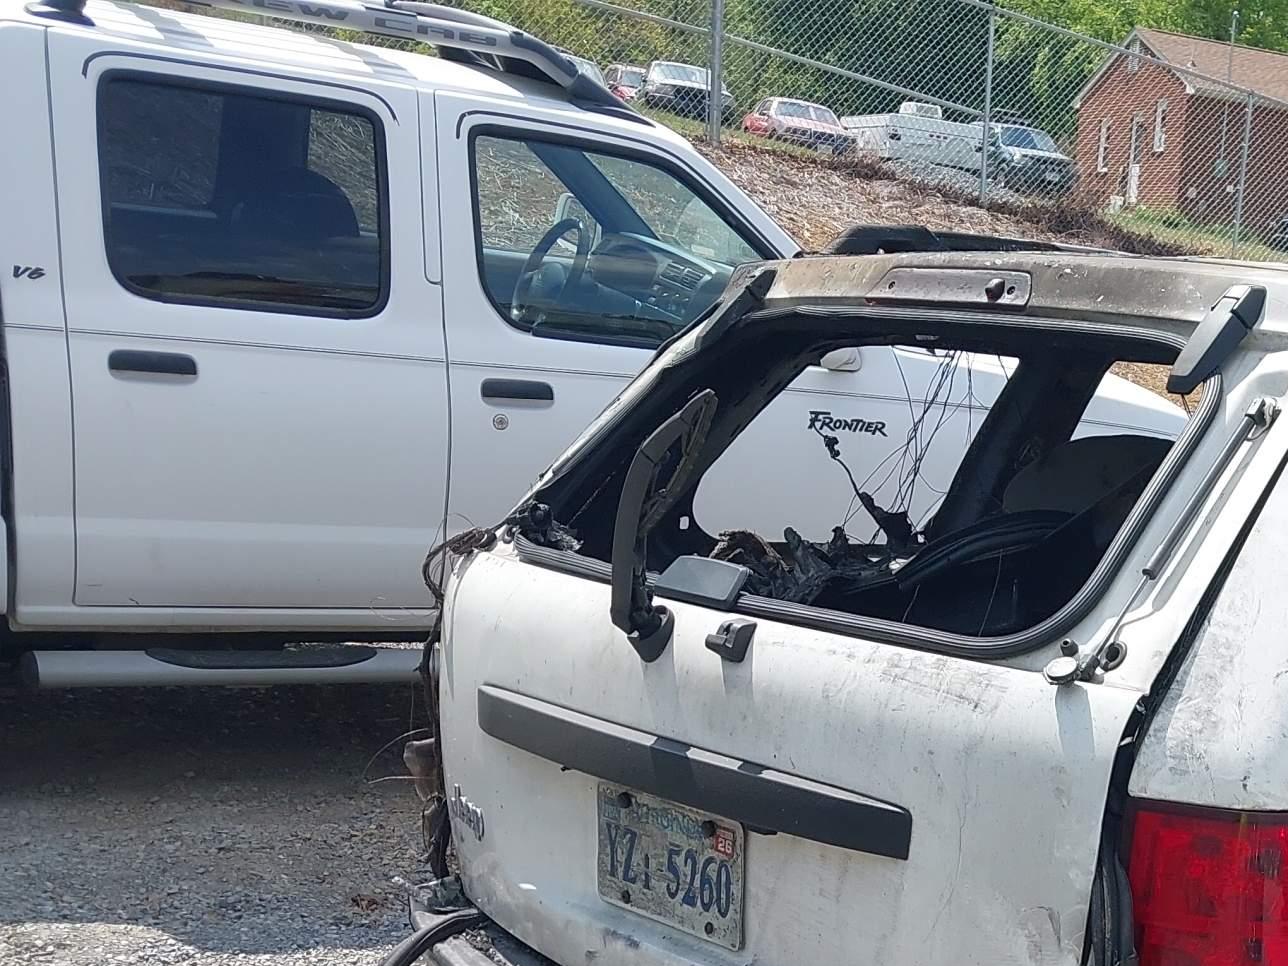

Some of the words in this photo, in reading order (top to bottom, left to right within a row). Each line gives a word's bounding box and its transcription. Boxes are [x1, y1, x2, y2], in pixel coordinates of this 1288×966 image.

[374, 17, 497, 47] CAB
[13, 264, 46, 280] V6
[807, 410, 888, 437] FRONTIER
[717, 836, 733, 854] 26
[665, 847, 733, 919] 5260
